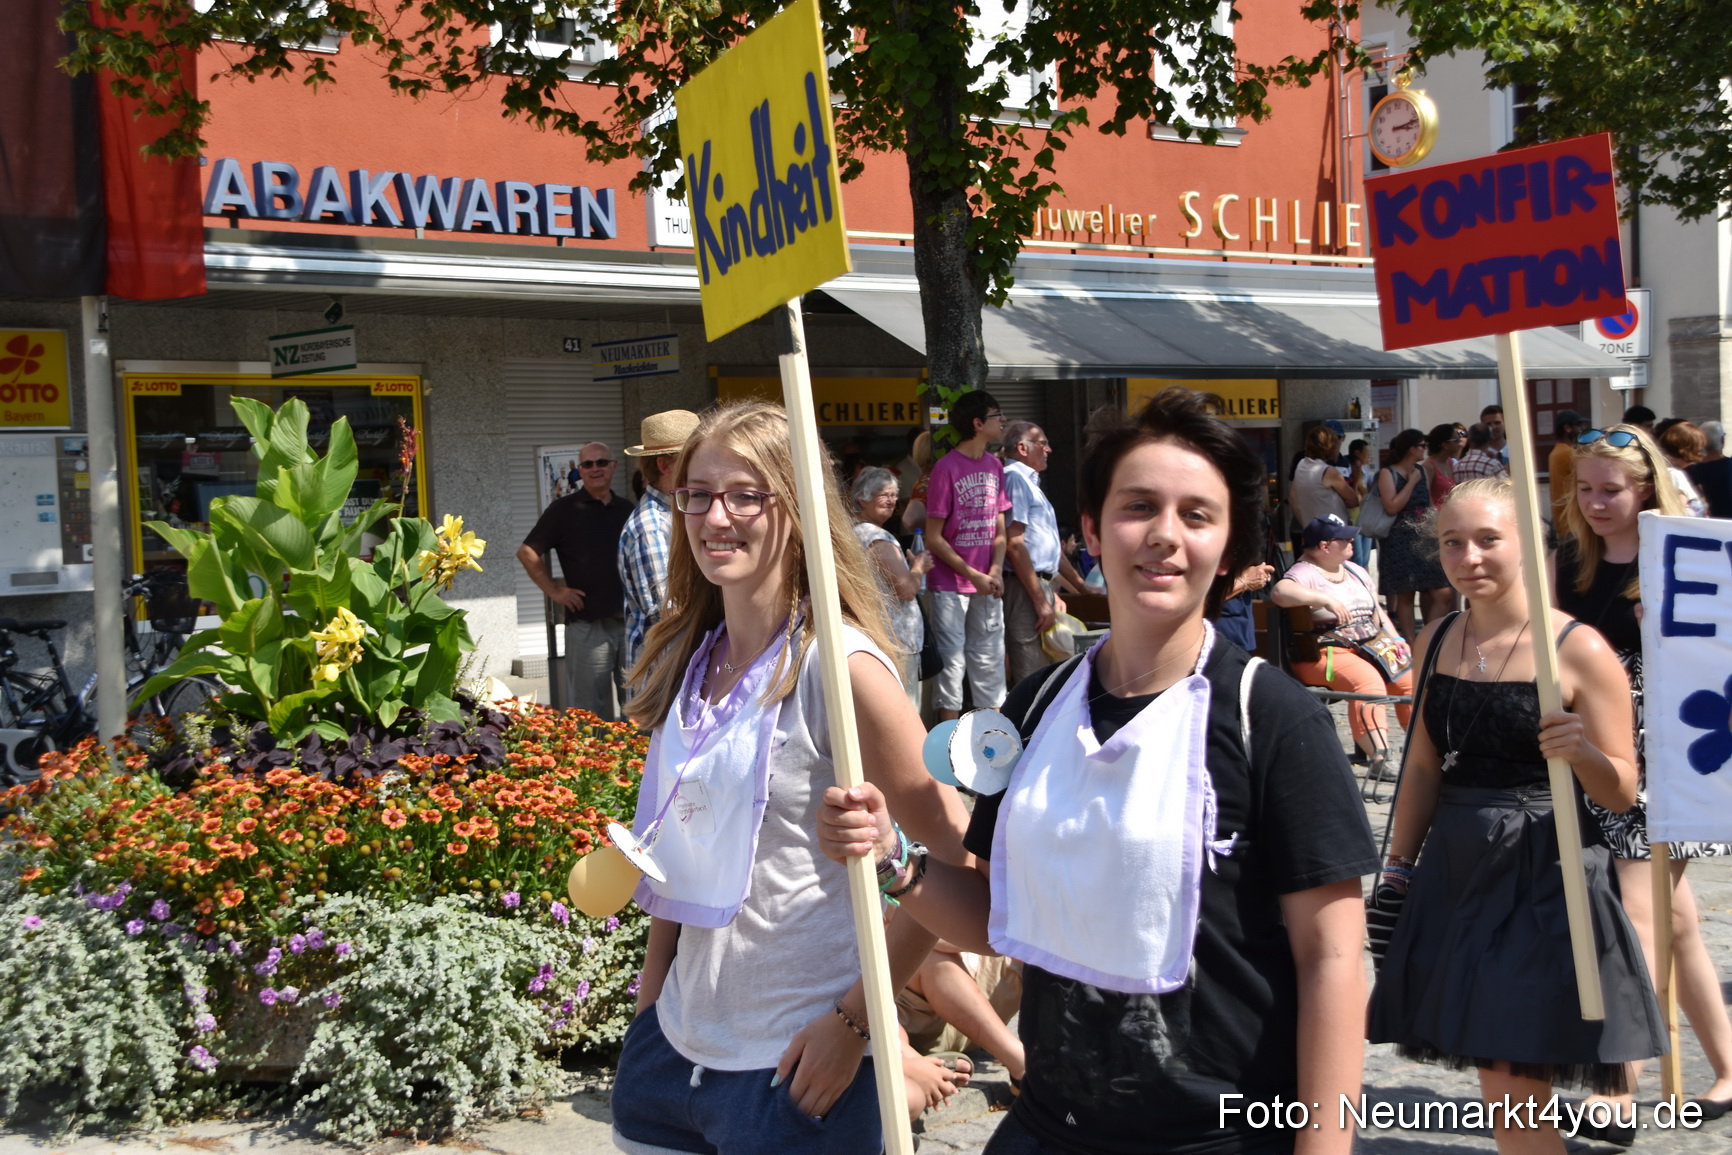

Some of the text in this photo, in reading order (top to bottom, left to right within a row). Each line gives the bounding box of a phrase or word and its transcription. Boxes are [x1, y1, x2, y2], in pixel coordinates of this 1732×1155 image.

[688, 72, 831, 285] Kindheit
[201, 156, 617, 239] ABAKWAREN
[1374, 155, 1611, 248] KONFIR-
[1178, 191, 1361, 246] SCHLIE
[1391, 237, 1625, 324] MATION
[274, 337, 352, 367] NZ NORDBAYERISCHE
[565, 339, 580, 351] 41
[601, 341, 671, 363] NEUMARKTER
[1599, 342, 1634, 354] ZONE
[301, 352, 326, 363] ZEITUNG
[613, 362, 658, 375] Nachrichten
[0, 383, 60, 404] OTTO
[145, 382, 178, 391] LOTTO
[385, 383, 414, 392] LOTTO
[4, 410, 45, 423] Bayern
[818, 402, 920, 423] CHLIERF
[1660, 534, 1732, 637] E
